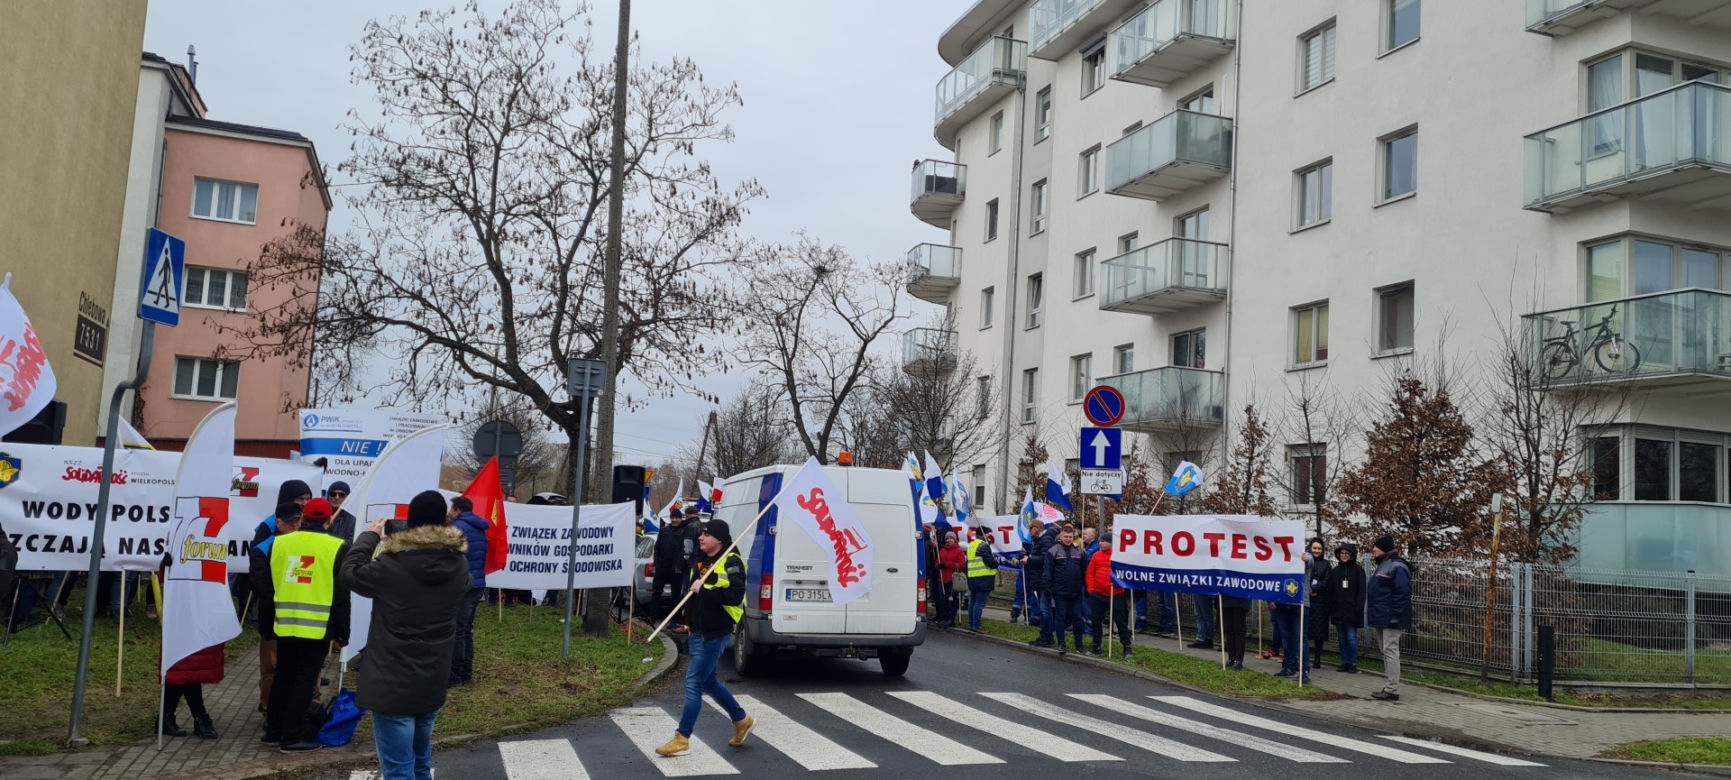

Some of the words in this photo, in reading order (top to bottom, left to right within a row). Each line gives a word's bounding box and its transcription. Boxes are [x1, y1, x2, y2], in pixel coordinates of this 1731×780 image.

[79, 290, 106, 325] Chlebowa
[341, 441, 371, 454] NIE
[131, 478, 176, 486] WIELKOPOLS
[1096, 471, 1121, 479] dotyczy
[22, 501, 98, 521] WODY
[111, 504, 171, 523] POLS
[512, 526, 557, 541] ZWIĄZEK
[952, 525, 1014, 545] TEST
[118, 537, 165, 555] NAS
[507, 541, 550, 557] WNIKÓW
[1119, 528, 1295, 562] PROTEST
[509, 560, 558, 573] OCHRONY
[561, 559, 622, 574] ŚODOWISKA
[1115, 569, 1155, 583] WOLNE
[1158, 573, 1213, 588] ZWIĄZKI
[1216, 576, 1281, 592] ZAWODOWE
